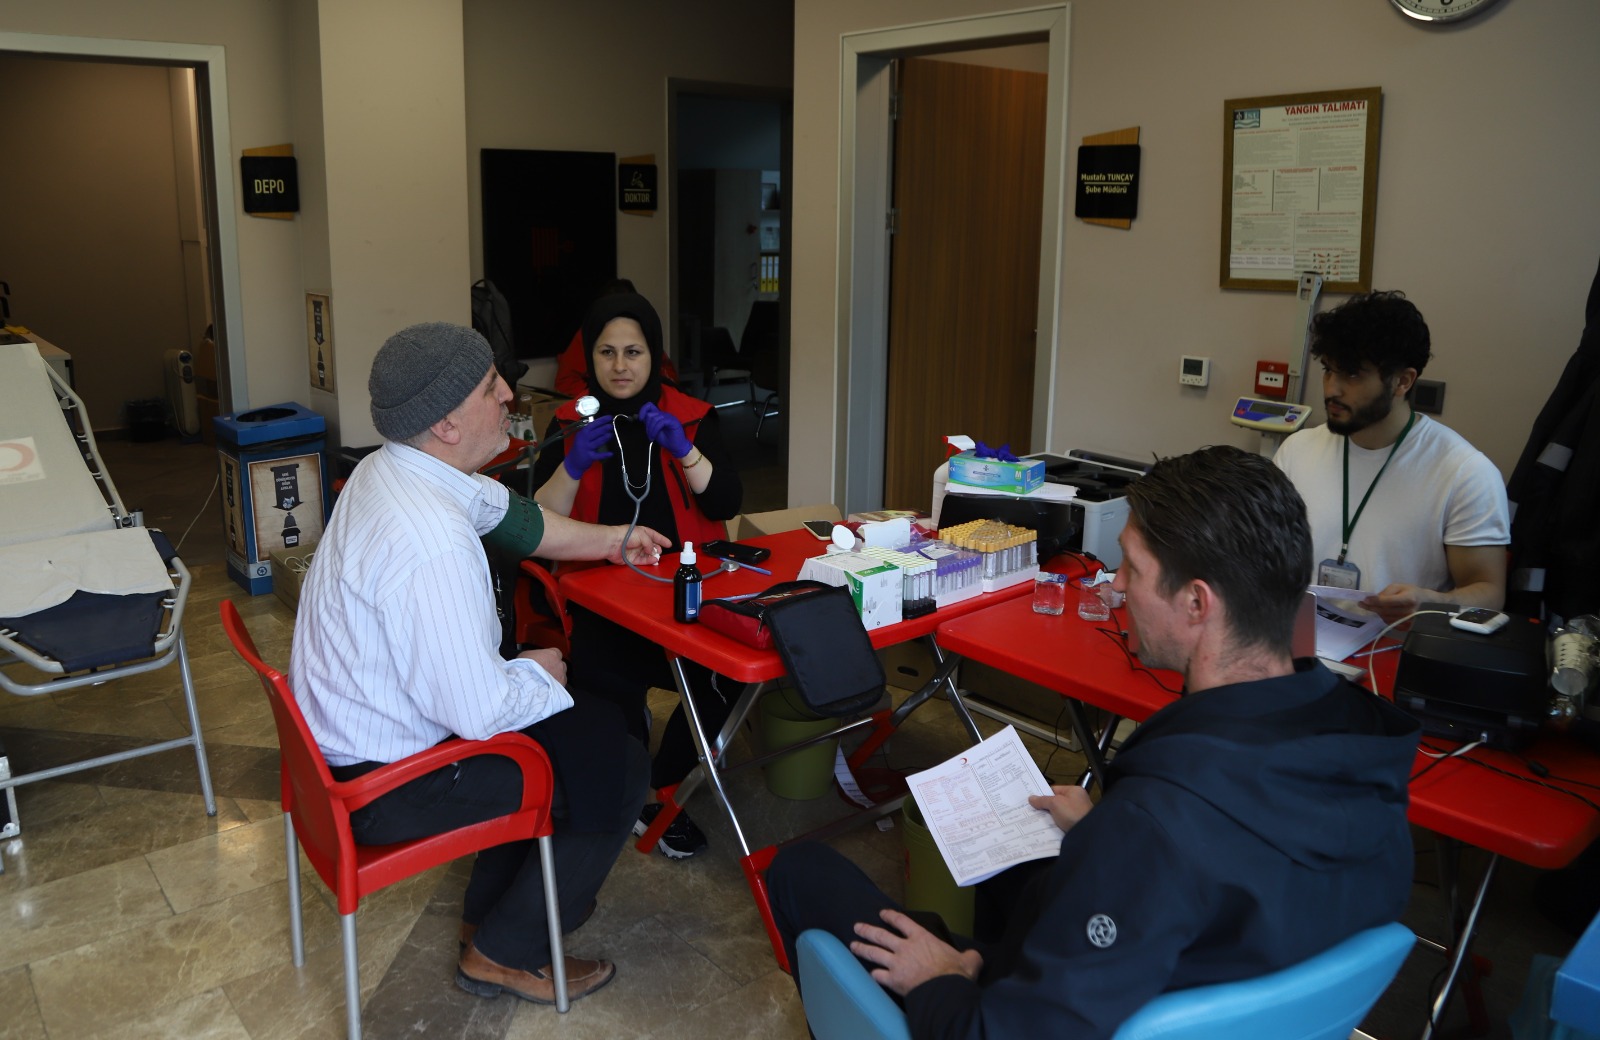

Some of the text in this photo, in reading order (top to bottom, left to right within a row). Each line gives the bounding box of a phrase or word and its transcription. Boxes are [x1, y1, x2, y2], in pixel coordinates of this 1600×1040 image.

[1285, 103, 1319, 116] YANGIN
[1081, 173, 1134, 182] Mustafa TUNÇAY
[254, 178, 285, 194] DEPO
[1085, 185, 1127, 194] Şube Müdürü
[624, 192, 650, 203] DOKTOR
